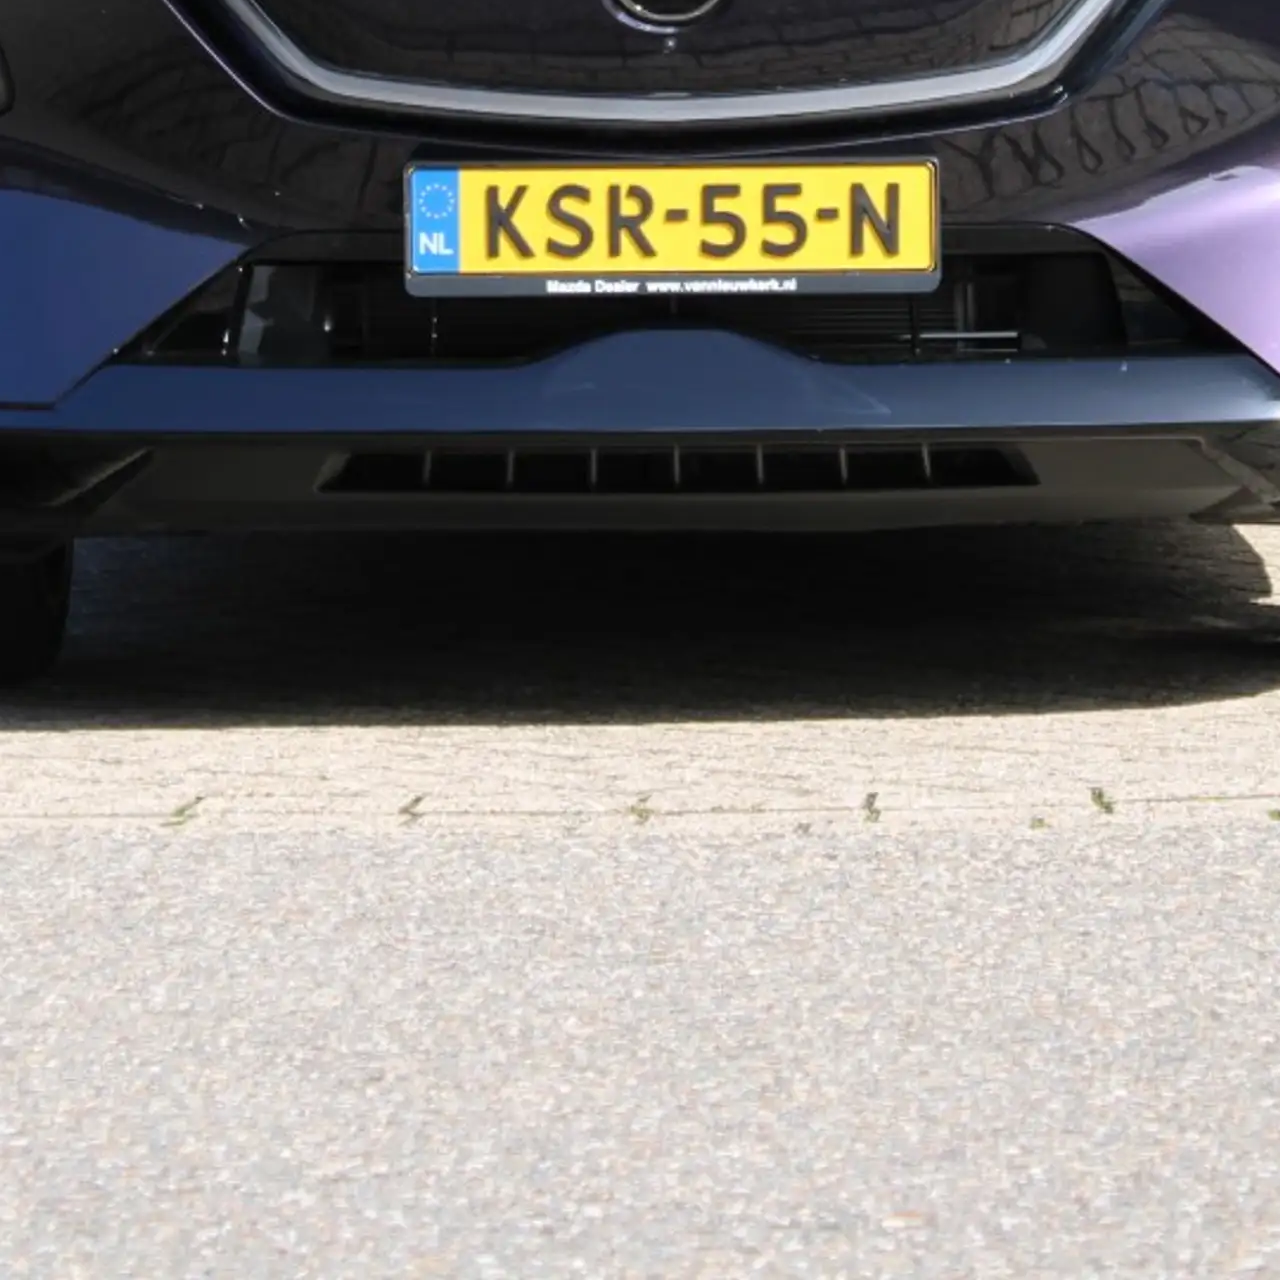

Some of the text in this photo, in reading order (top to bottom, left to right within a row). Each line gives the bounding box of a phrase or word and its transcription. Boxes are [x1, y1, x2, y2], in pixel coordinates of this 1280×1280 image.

[484, 182, 901, 261] KSR-55-N
[419, 232, 454, 256] NL
[546, 279, 592, 293] Mazda
[594, 279, 640, 293] Dealer
